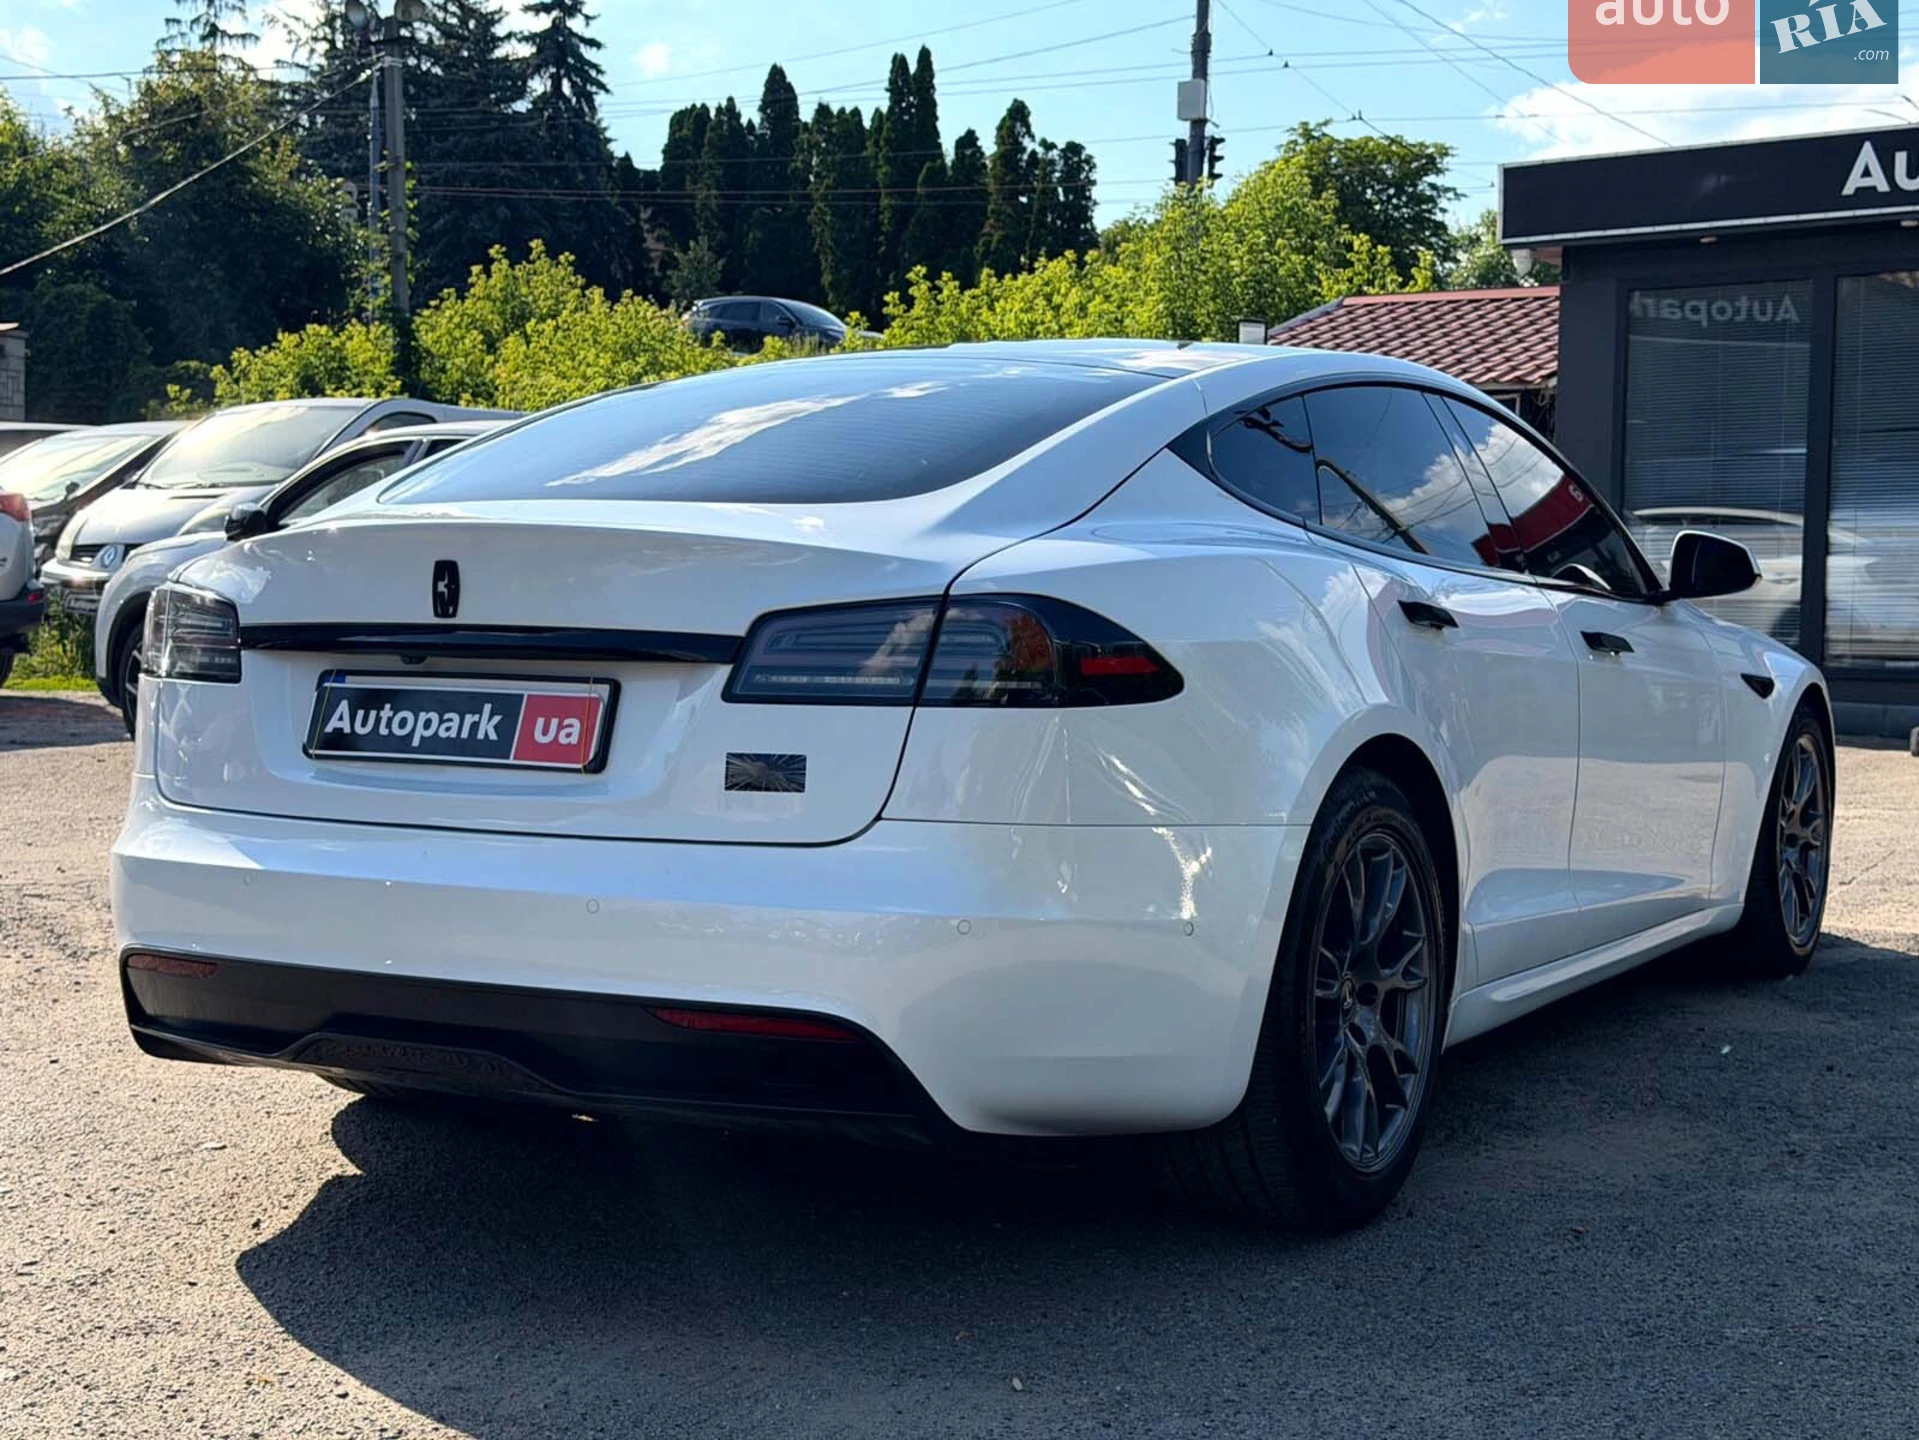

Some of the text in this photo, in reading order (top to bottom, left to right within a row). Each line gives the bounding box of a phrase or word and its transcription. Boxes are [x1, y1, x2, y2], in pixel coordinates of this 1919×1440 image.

[1841, 140, 1919, 196] Au
[324, 699, 582, 748] Autopark ua
